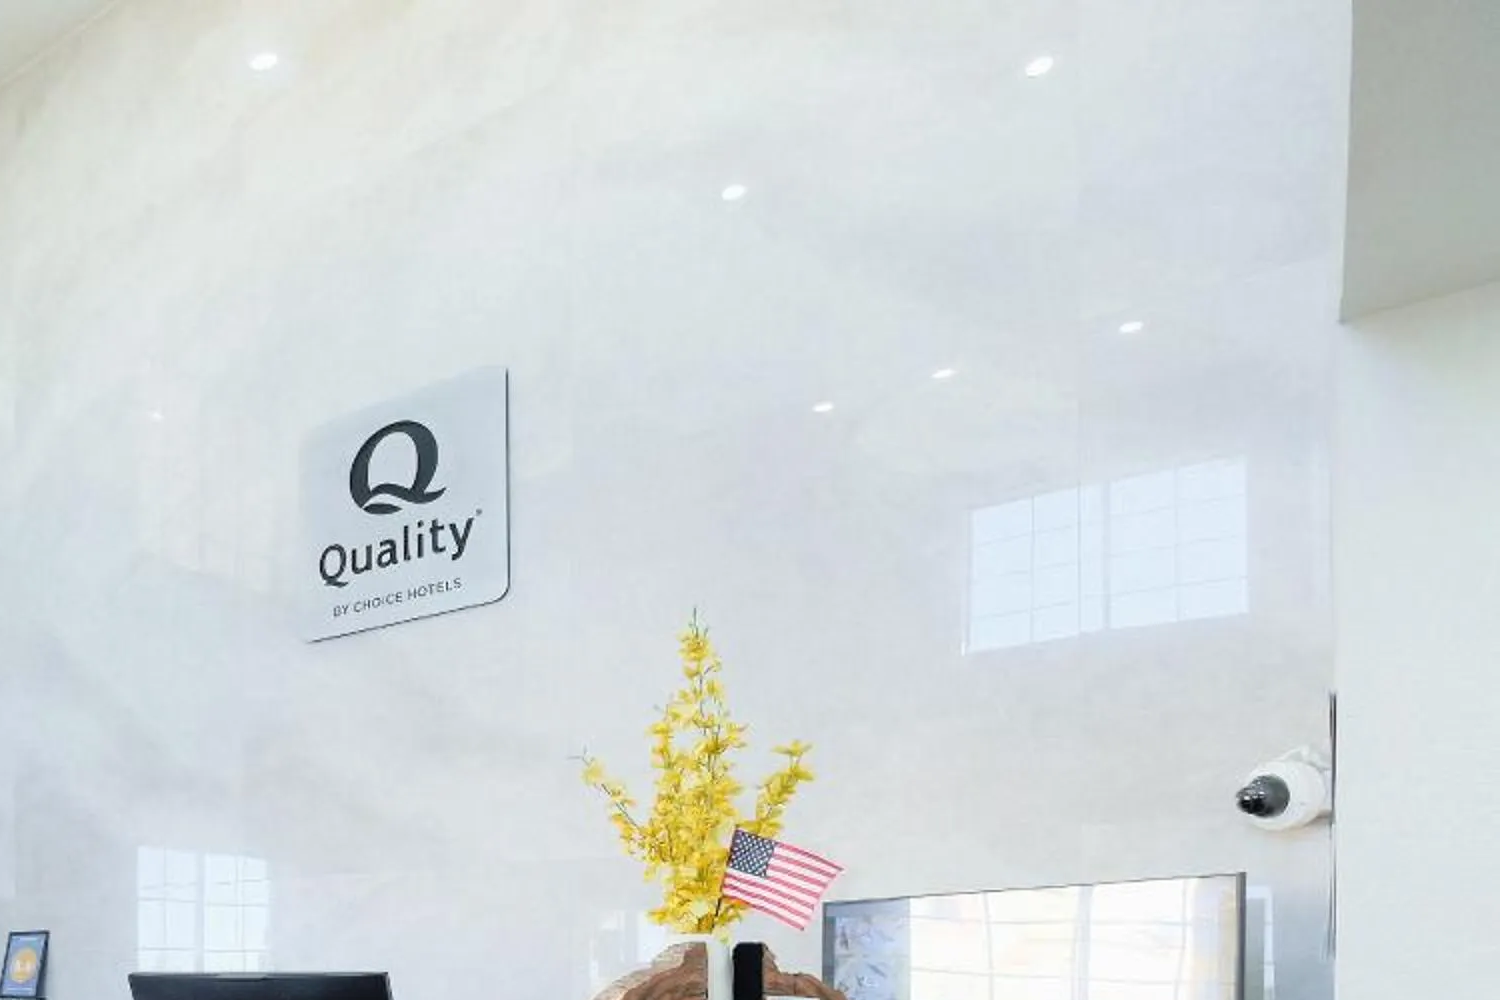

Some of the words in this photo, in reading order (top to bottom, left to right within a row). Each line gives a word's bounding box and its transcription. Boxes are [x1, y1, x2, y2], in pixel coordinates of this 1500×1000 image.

[349, 419, 447, 515] Q
[319, 517, 476, 588] Quality
[333, 604, 349, 617] BY
[353, 591, 403, 613] CHOICE
[407, 577, 463, 600] HOTELS
